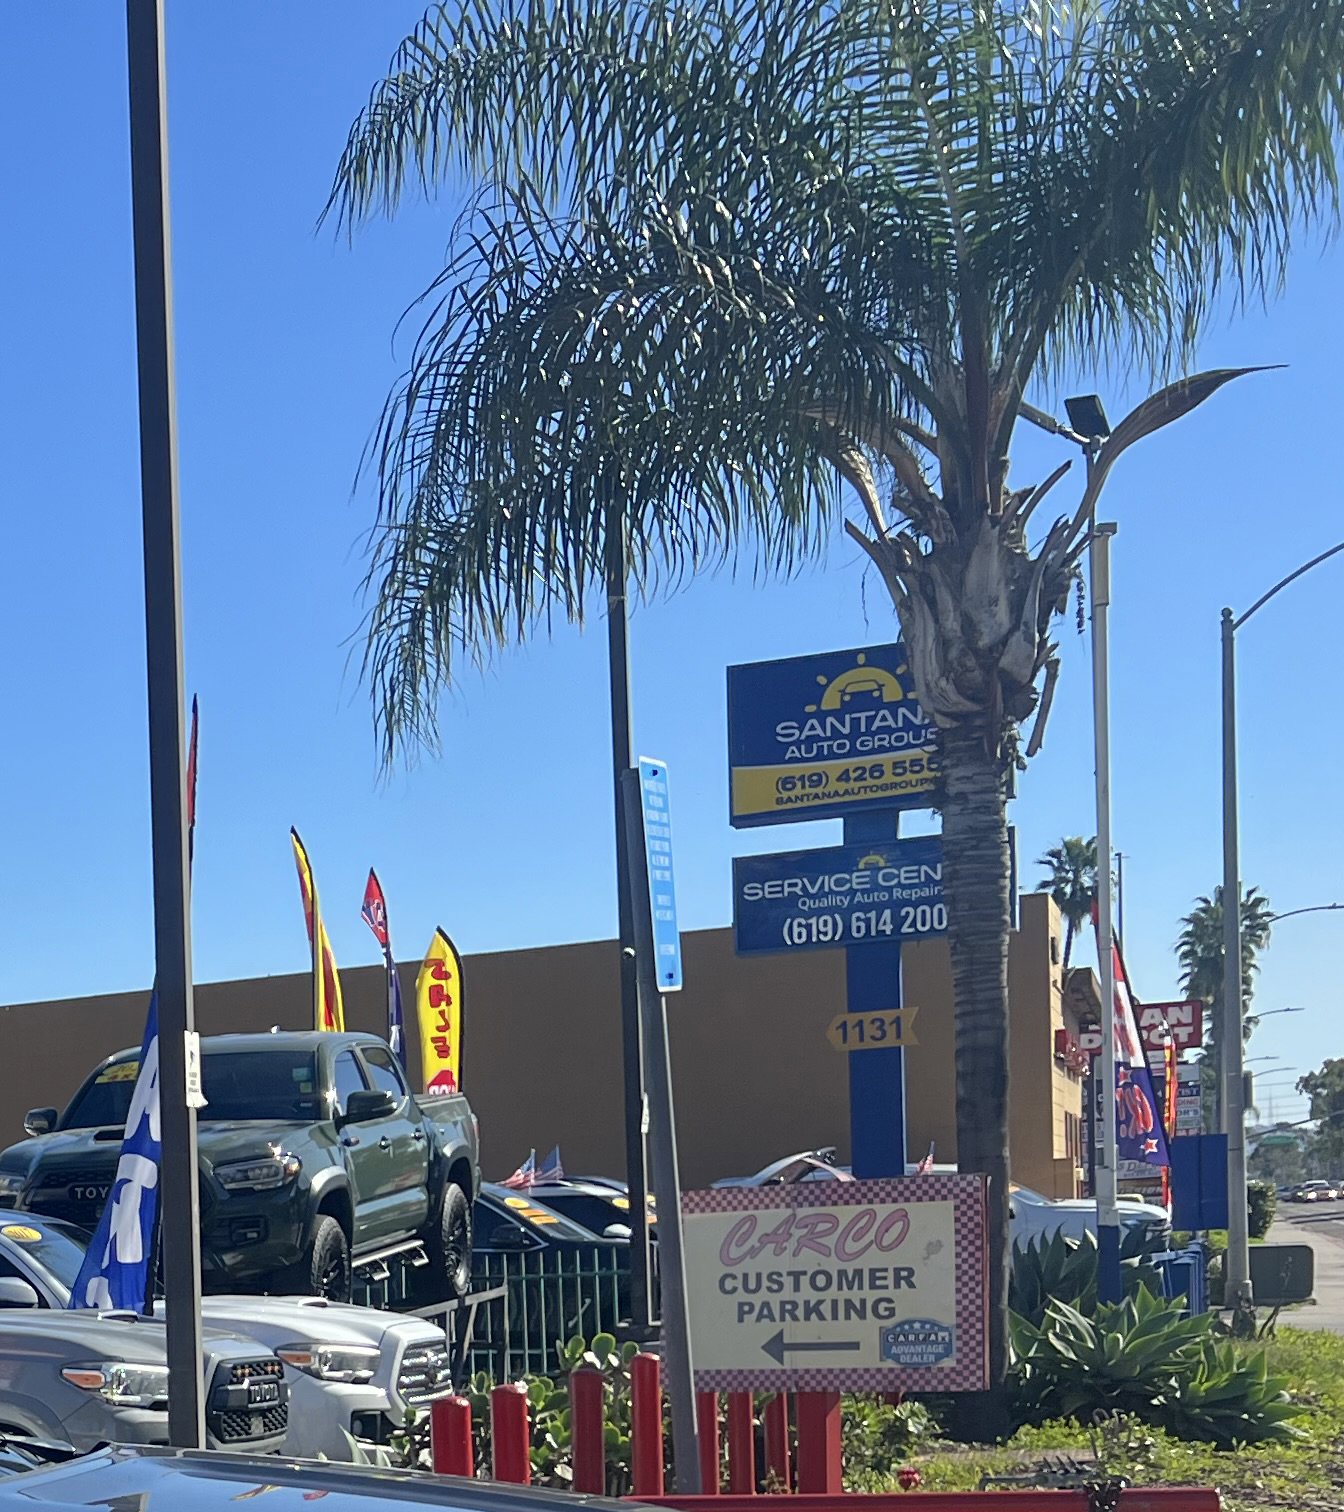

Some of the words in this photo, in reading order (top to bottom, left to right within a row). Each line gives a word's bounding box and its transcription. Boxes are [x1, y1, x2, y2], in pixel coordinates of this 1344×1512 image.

[775, 704, 932, 743] SANTAN
[784, 739, 850, 760] AUTO
[775, 770, 830, 795] (619)
[835, 763, 885, 785] 426
[743, 870, 872, 901] SERVICE
[798, 894, 850, 912] Quality
[853, 890, 889, 905] Auto
[782, 913, 844, 946] (619)
[851, 909, 894, 940] 614
[835, 1015, 902, 1045] 1131
[719, 1207, 911, 1267] CARCO
[718, 1266, 917, 1295] CUSTOMER
[736, 1297, 897, 1323] PARKING
[890, 1344, 945, 1354] ADVANTAGE
